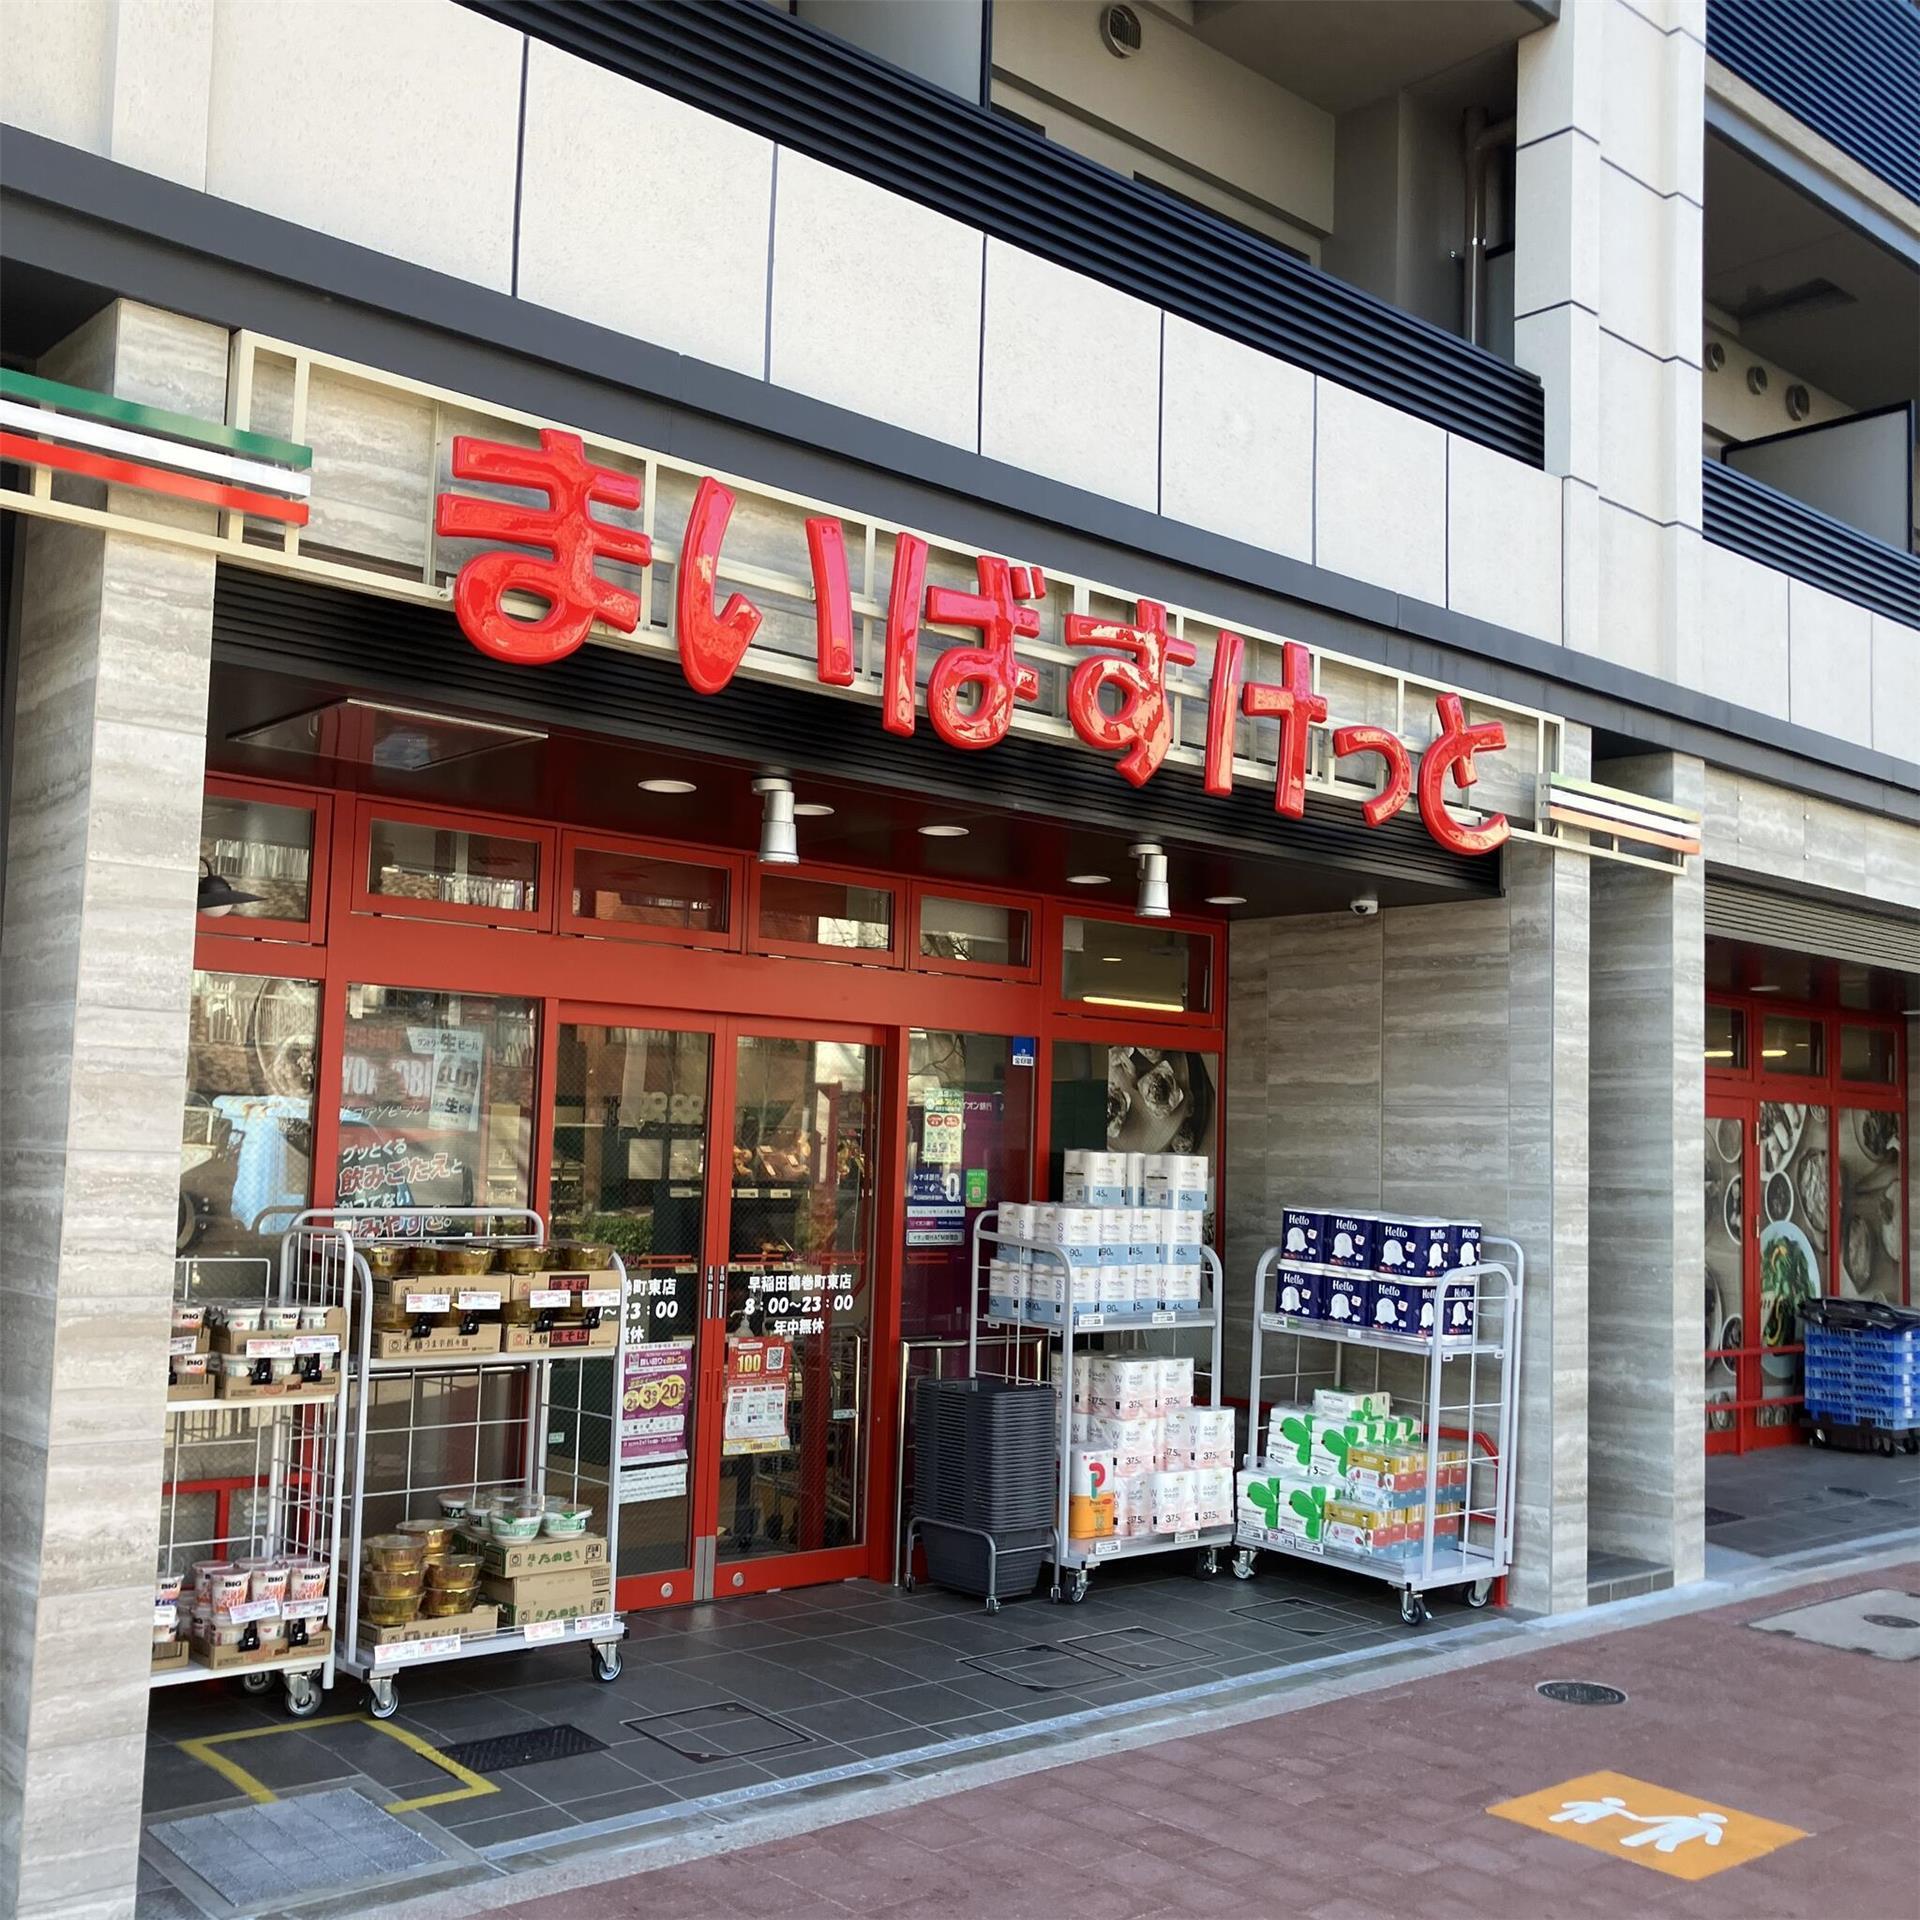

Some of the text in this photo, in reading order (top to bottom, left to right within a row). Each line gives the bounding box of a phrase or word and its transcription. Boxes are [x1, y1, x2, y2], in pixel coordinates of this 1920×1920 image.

[436, 428, 1509, 856] まいばすけっと
[342, 1138, 407, 1163] グッとくる
[1288, 1213, 1310, 1226] Hello
[1335, 1218, 1358, 1232] Hello
[1384, 1225, 1408, 1239] Hello
[1430, 1229, 1446, 1240] Hello
[1462, 1228, 1479, 1240] Hello
[747, 1273, 853, 1293] 早稲田鶴巻町東店
[1283, 1273, 1305, 1286] Hello
[1332, 1279, 1354, 1293] Hello
[1378, 1283, 1401, 1297] Hello
[1422, 1288, 1436, 1300] Hell
[1454, 1287, 1471, 1298] Hello
[282, 1312, 297, 1320] BIG
[773, 1317, 825, 1336] 年中無休
[736, 1353, 762, 1373] 100
[267, 1575, 284, 1583] BIG
[303, 1573, 321, 1581] BIG
[160, 1582, 178, 1591] BIG
[224, 1580, 243, 1588] BIG
